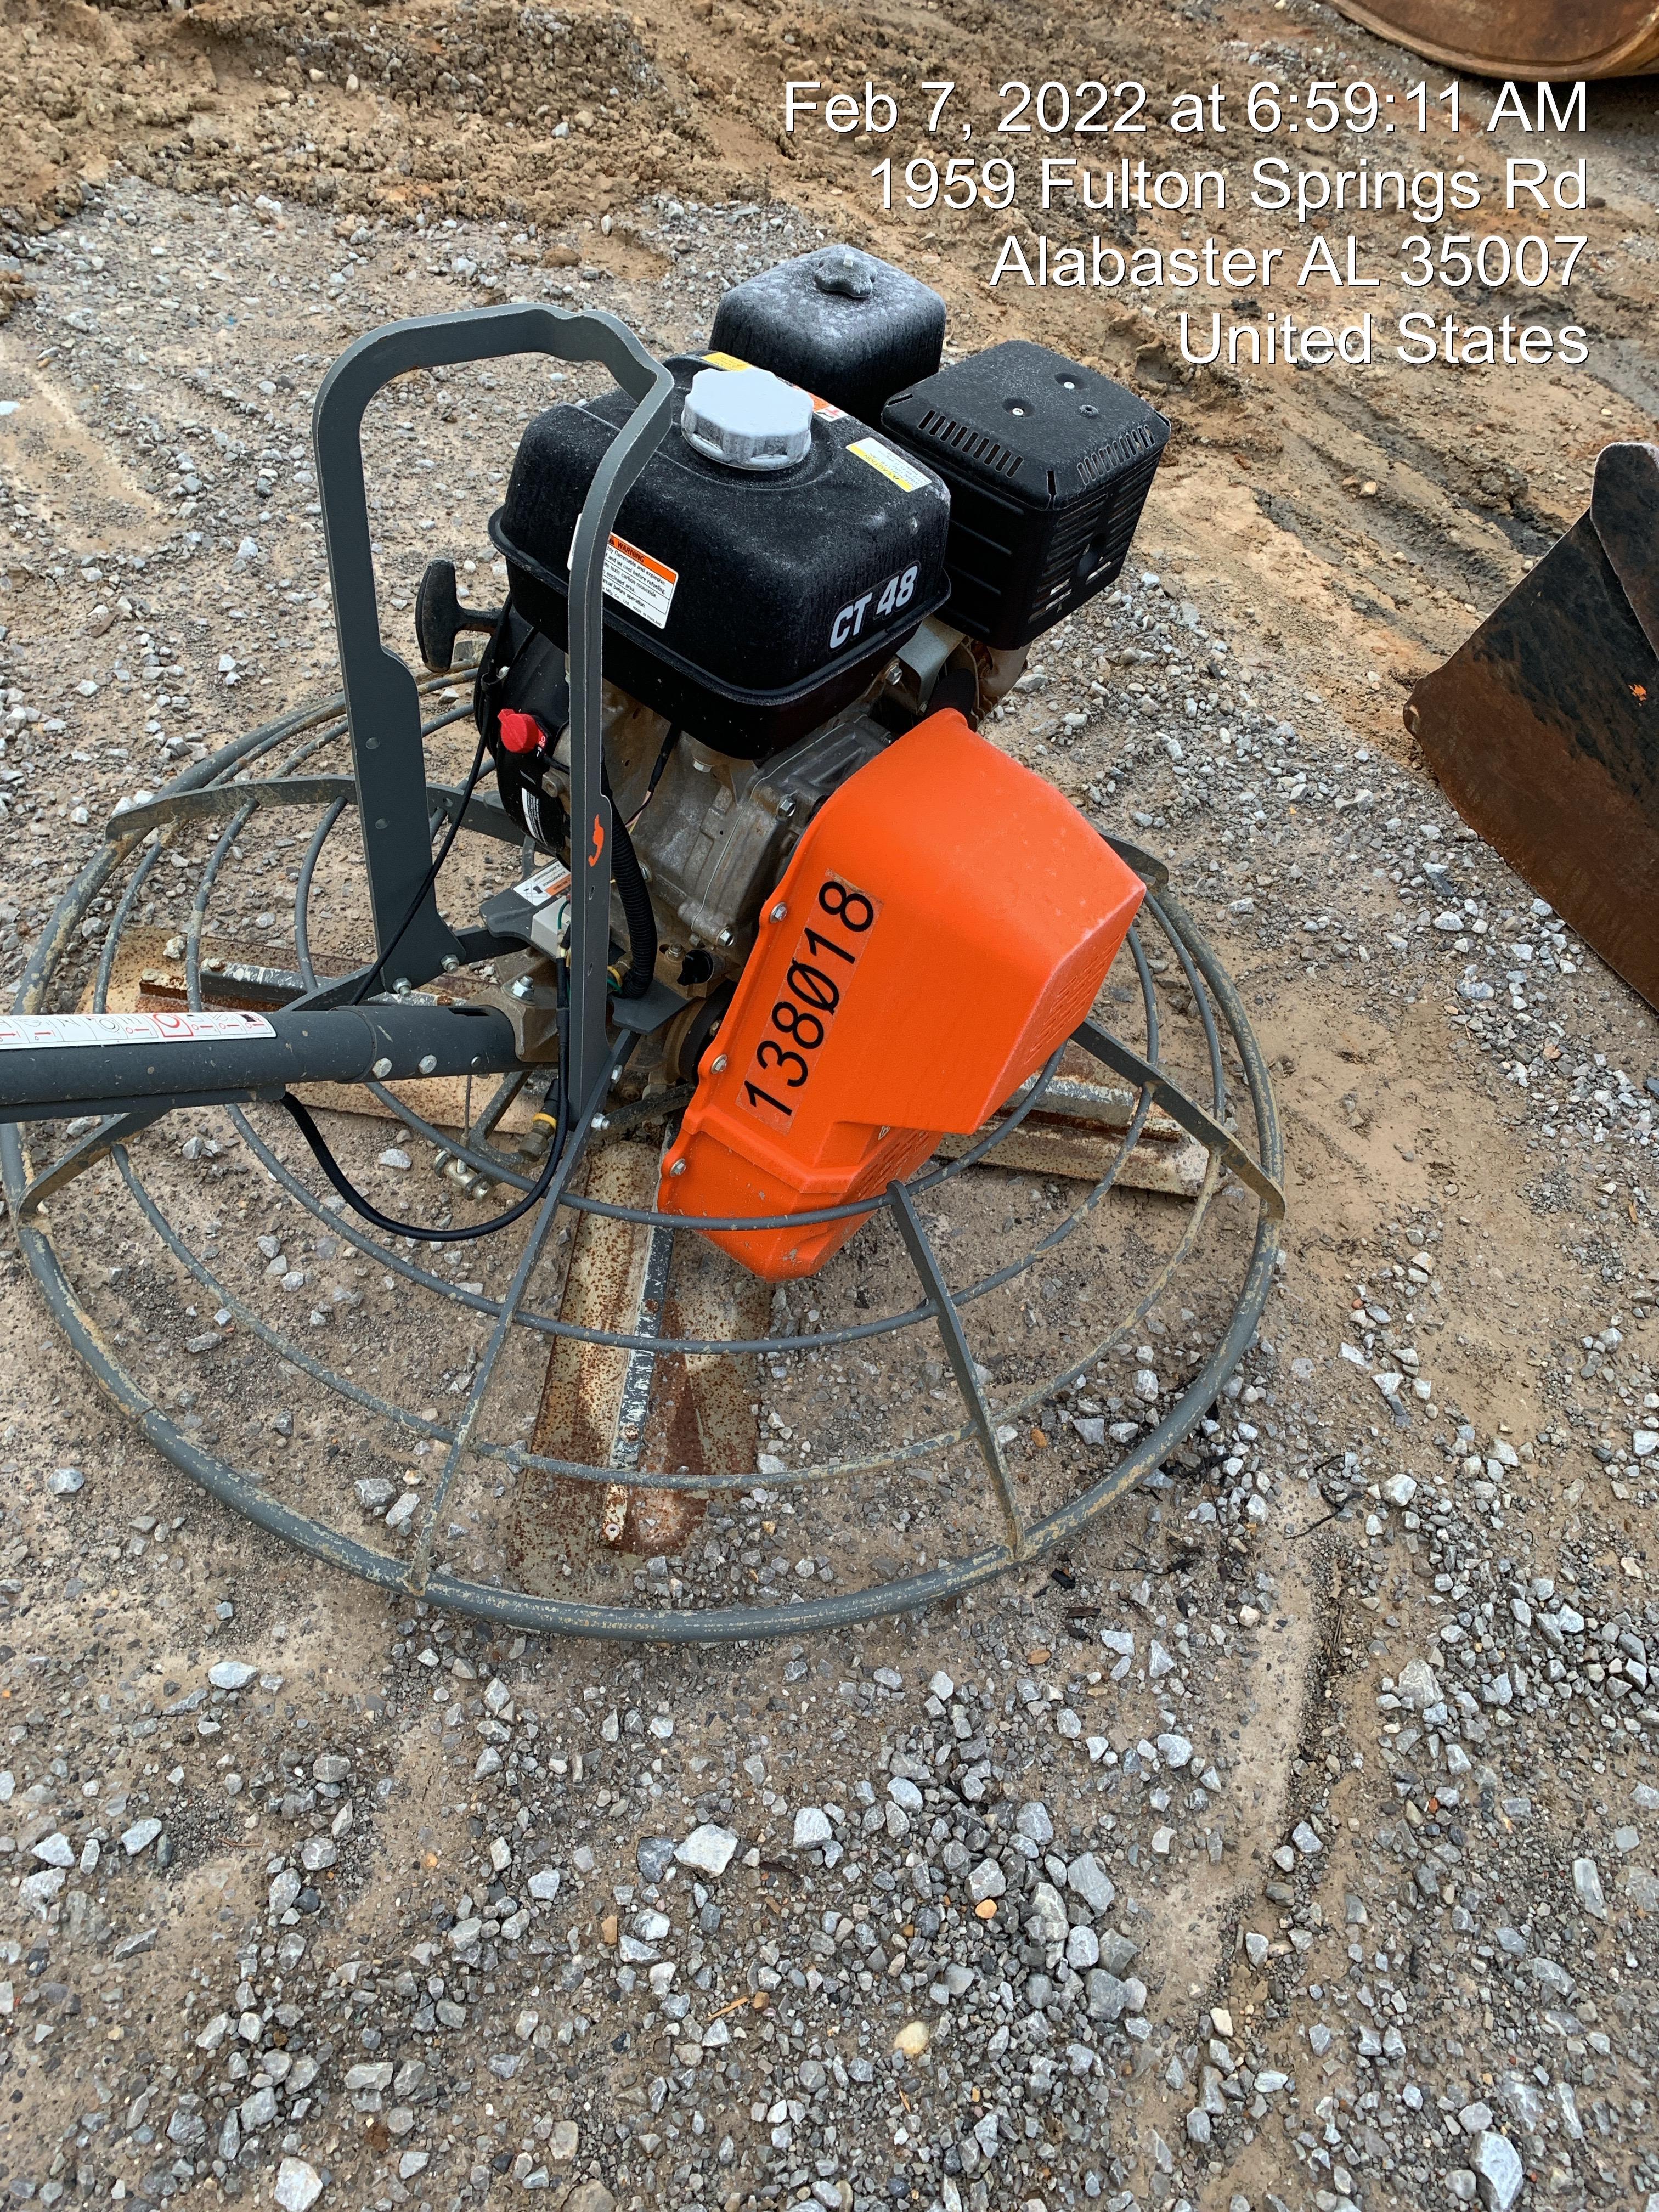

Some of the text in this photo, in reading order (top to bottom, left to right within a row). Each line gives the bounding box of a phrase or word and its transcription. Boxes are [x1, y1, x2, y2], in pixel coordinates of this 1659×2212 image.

[862, 454, 892, 476] CAUTION
[607, 554, 617, 563] and
[623, 563, 633, 573] cool
[632, 569, 646, 582] before
[614, 550, 636, 567] flammable
[636, 564, 646, 573] and
[645, 569, 667, 586] explosive.
[617, 541, 645, 563] WARNING
[601, 577, 646, 609] anual before operation.
[606, 571, 625, 585] enclosed
[625, 583, 636, 593] area.
[610, 565, 620, 575] toxic
[620, 572, 636, 585] carbon
[635, 581, 658, 599] monoxide.
[830, 565, 918, 649] CT 48
[744, 881, 874, 1117] 138018
